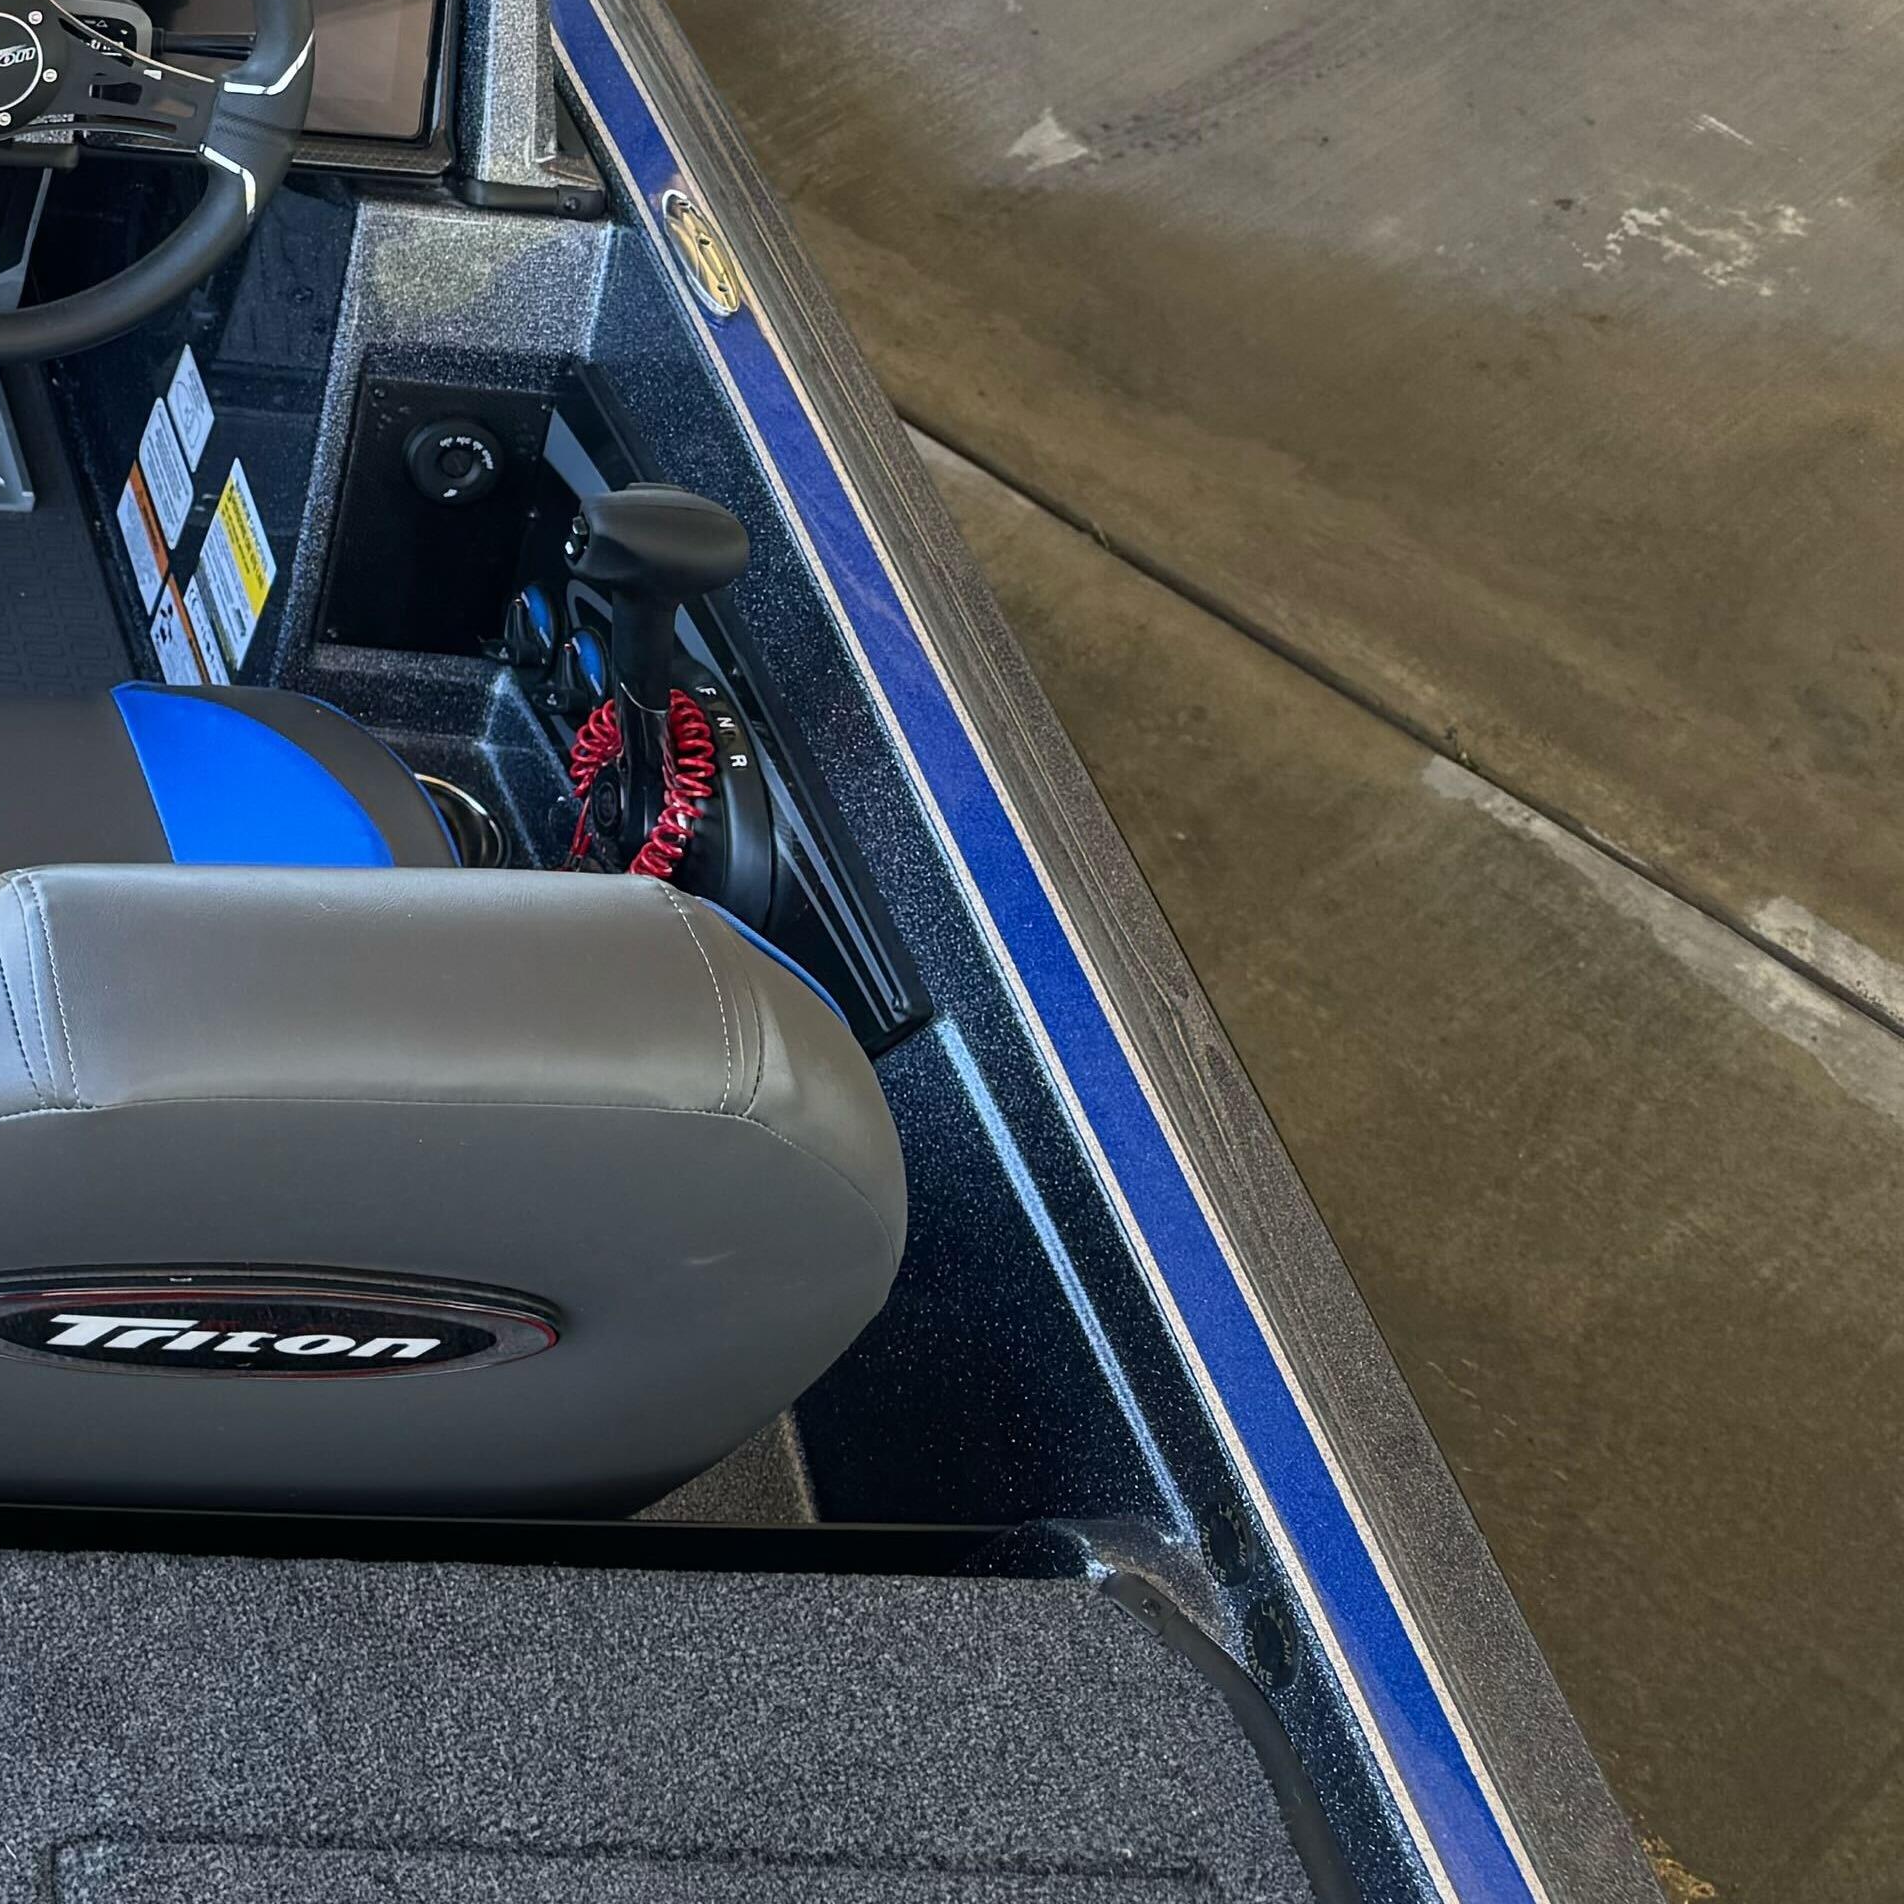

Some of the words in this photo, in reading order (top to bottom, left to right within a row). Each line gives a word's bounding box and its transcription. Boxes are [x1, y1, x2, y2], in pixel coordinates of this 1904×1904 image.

[695, 684, 717, 696] F
[716, 716, 737, 728] N
[730, 754, 748, 767] R
[45, 1313, 447, 1360] Triton
